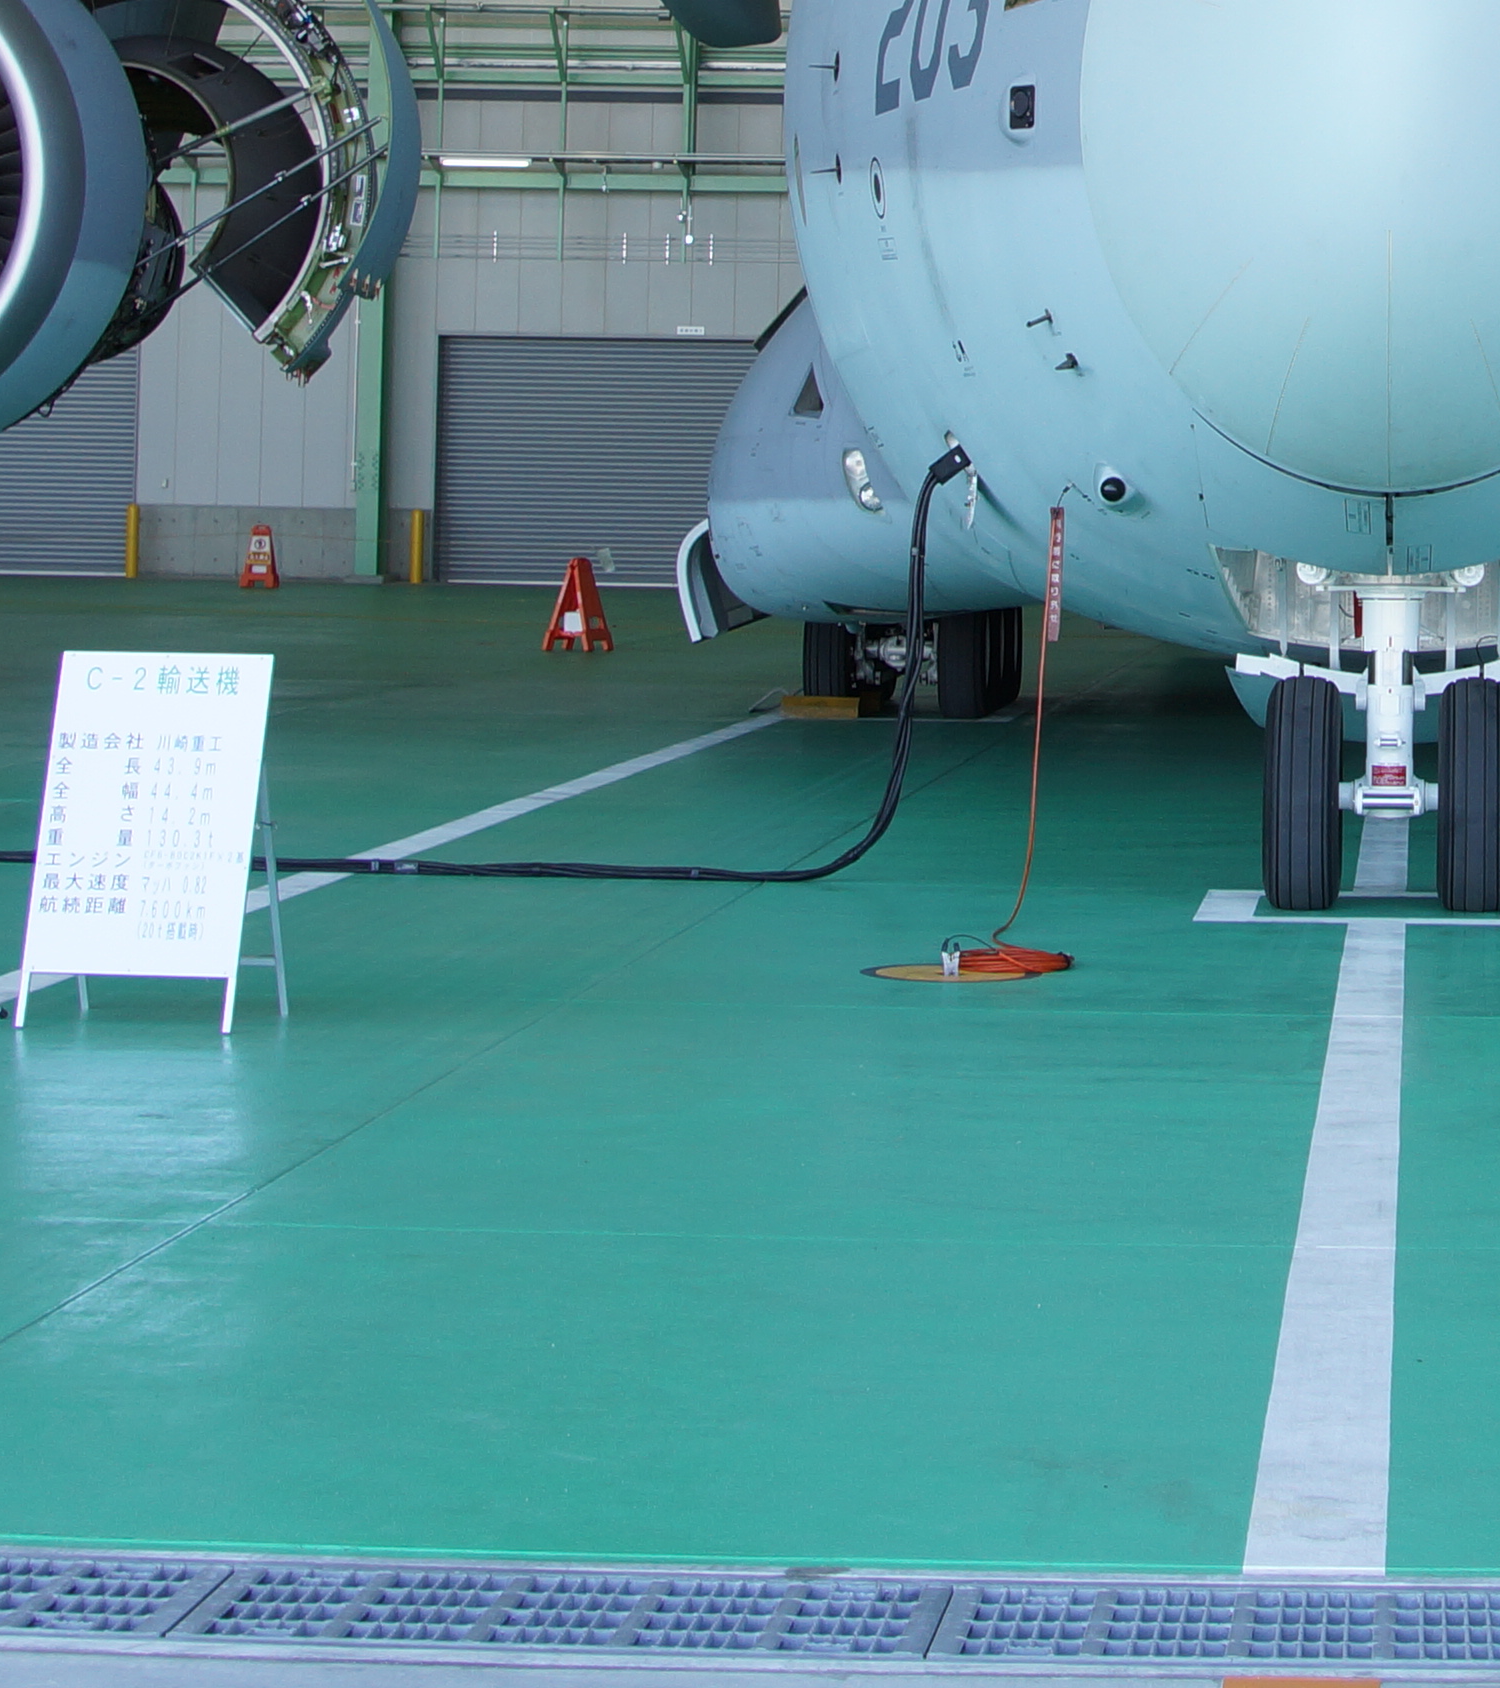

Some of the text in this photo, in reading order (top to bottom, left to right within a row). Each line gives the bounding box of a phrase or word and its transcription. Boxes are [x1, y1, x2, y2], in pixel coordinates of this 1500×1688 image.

[57, 732, 223, 752] 製造会社 川崎重工
[153, 758, 217, 776] 43.9m
[150, 782, 214, 800] 44.4m
[148, 806, 211, 825] 14.2m
[146, 829, 214, 848] 130.3t
[44, 851, 132, 868] エンジン
[41, 873, 208, 895] 最大速度 マッハ 0.82
[38, 897, 128, 915] 航続距離
